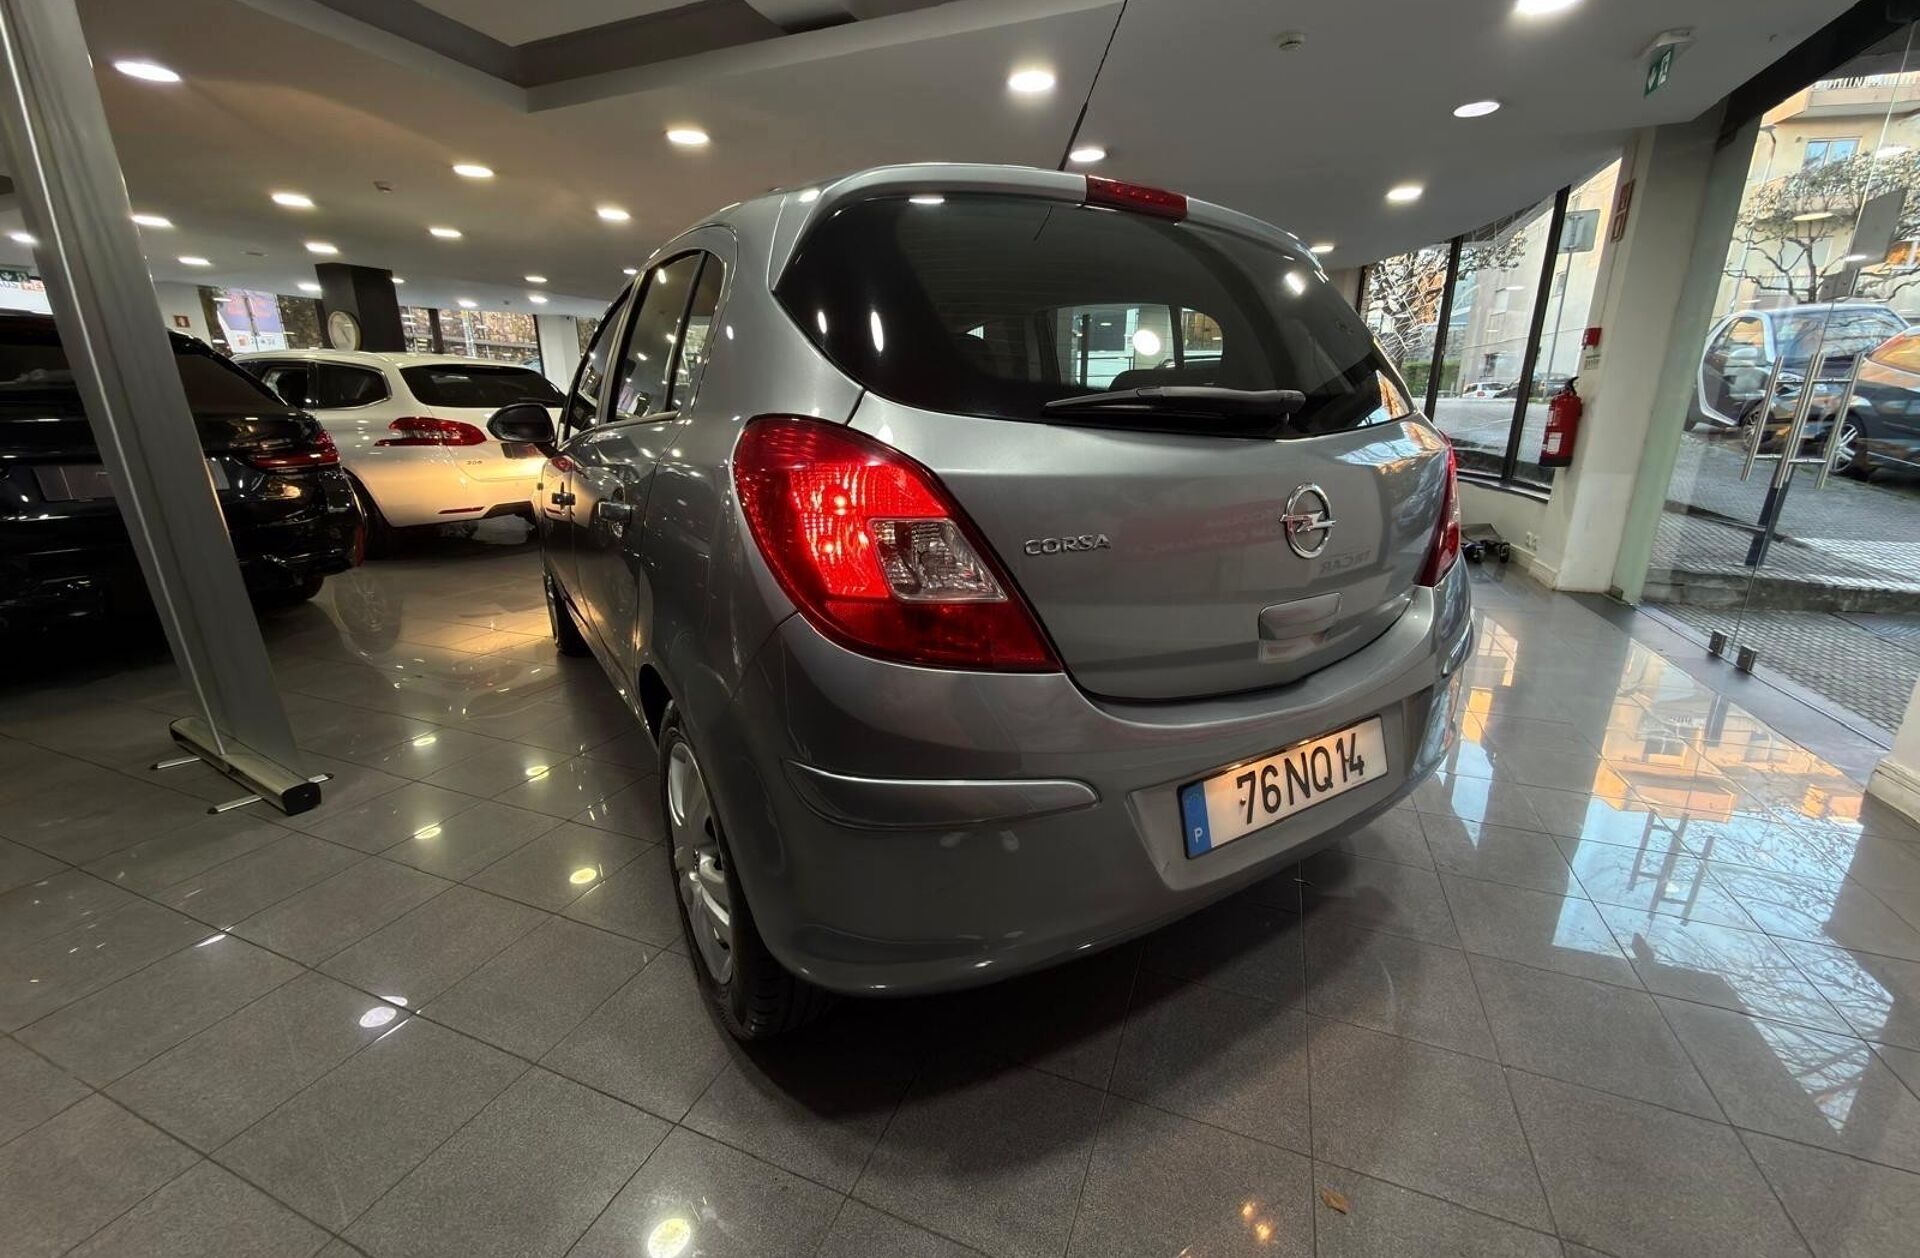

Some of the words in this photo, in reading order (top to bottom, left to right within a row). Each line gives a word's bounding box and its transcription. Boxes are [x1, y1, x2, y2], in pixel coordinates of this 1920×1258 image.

[1024, 534, 1111, 555] CORSA
[1237, 733, 1365, 825] 76NQ14
[1193, 827, 1203, 844] P
